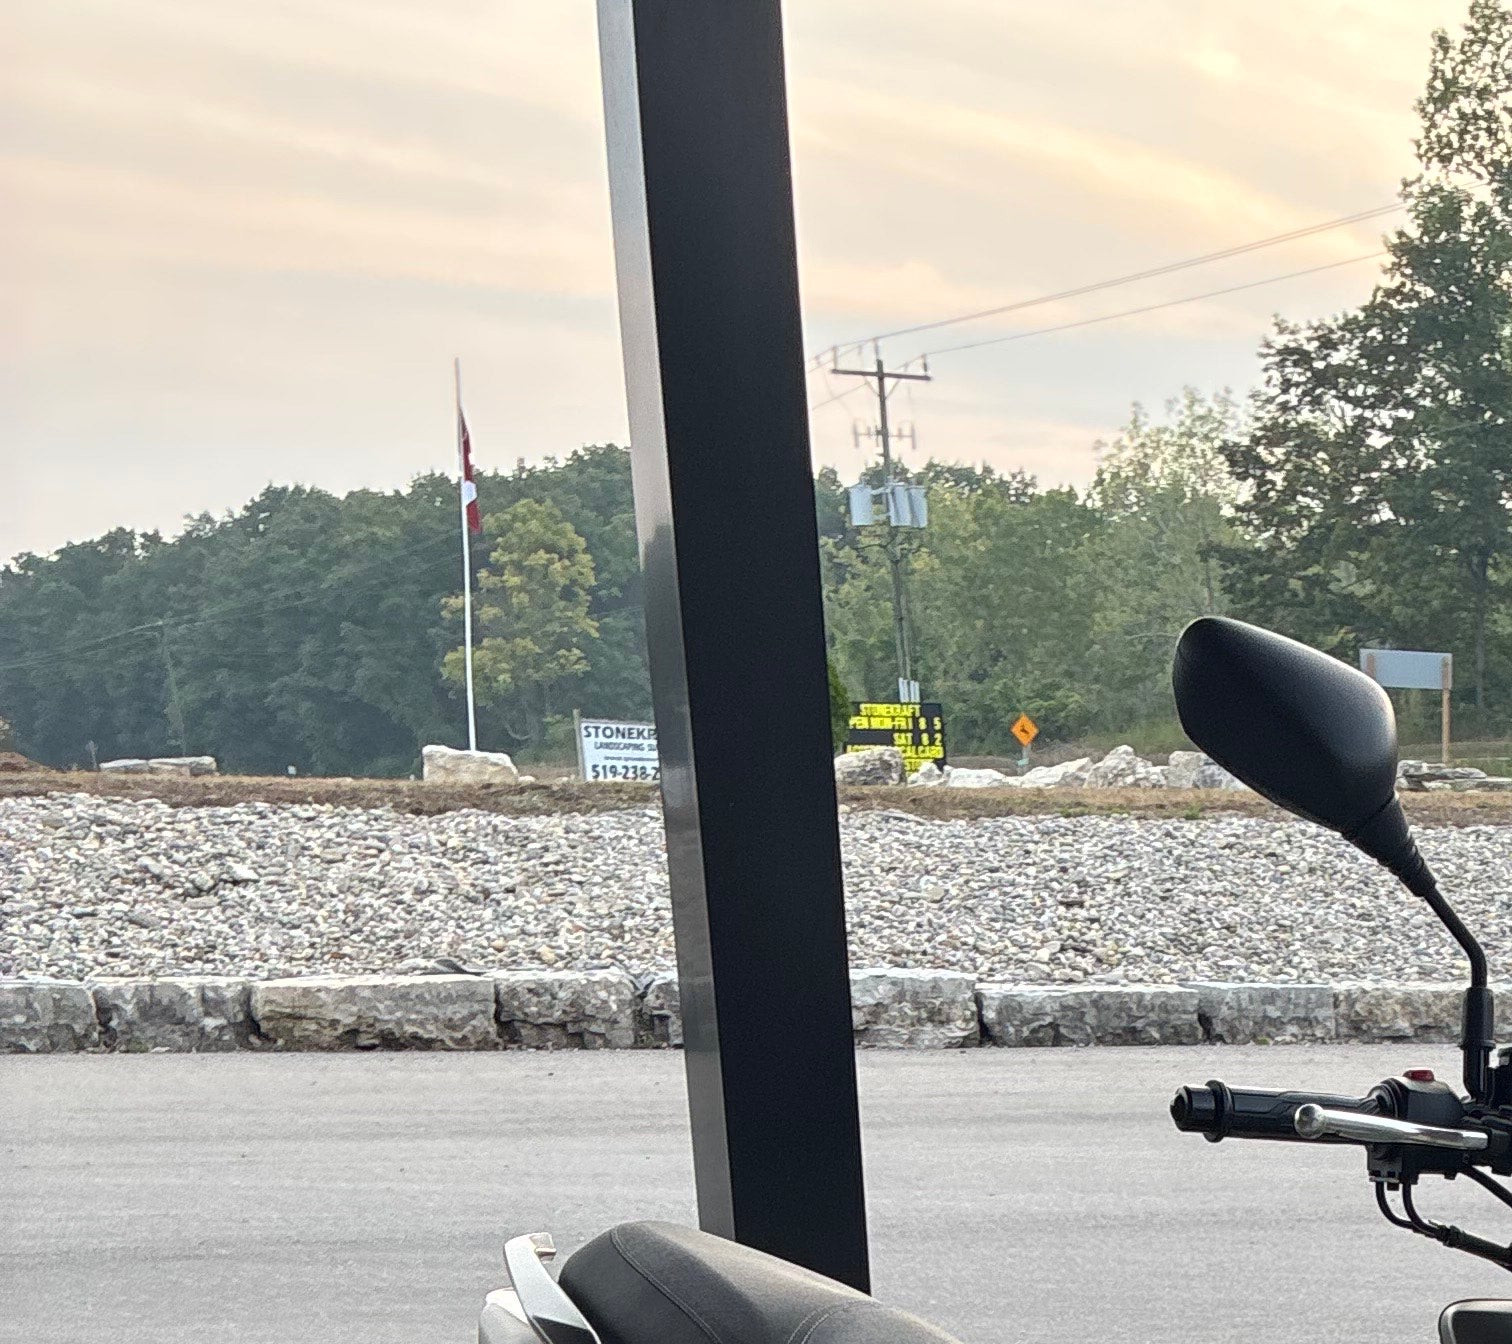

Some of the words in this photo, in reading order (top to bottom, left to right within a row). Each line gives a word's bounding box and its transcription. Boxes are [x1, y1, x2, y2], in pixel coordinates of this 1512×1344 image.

[933, 717, 942, 730] 5
[893, 733, 913, 745] SAT
[934, 733, 942, 745] 2
